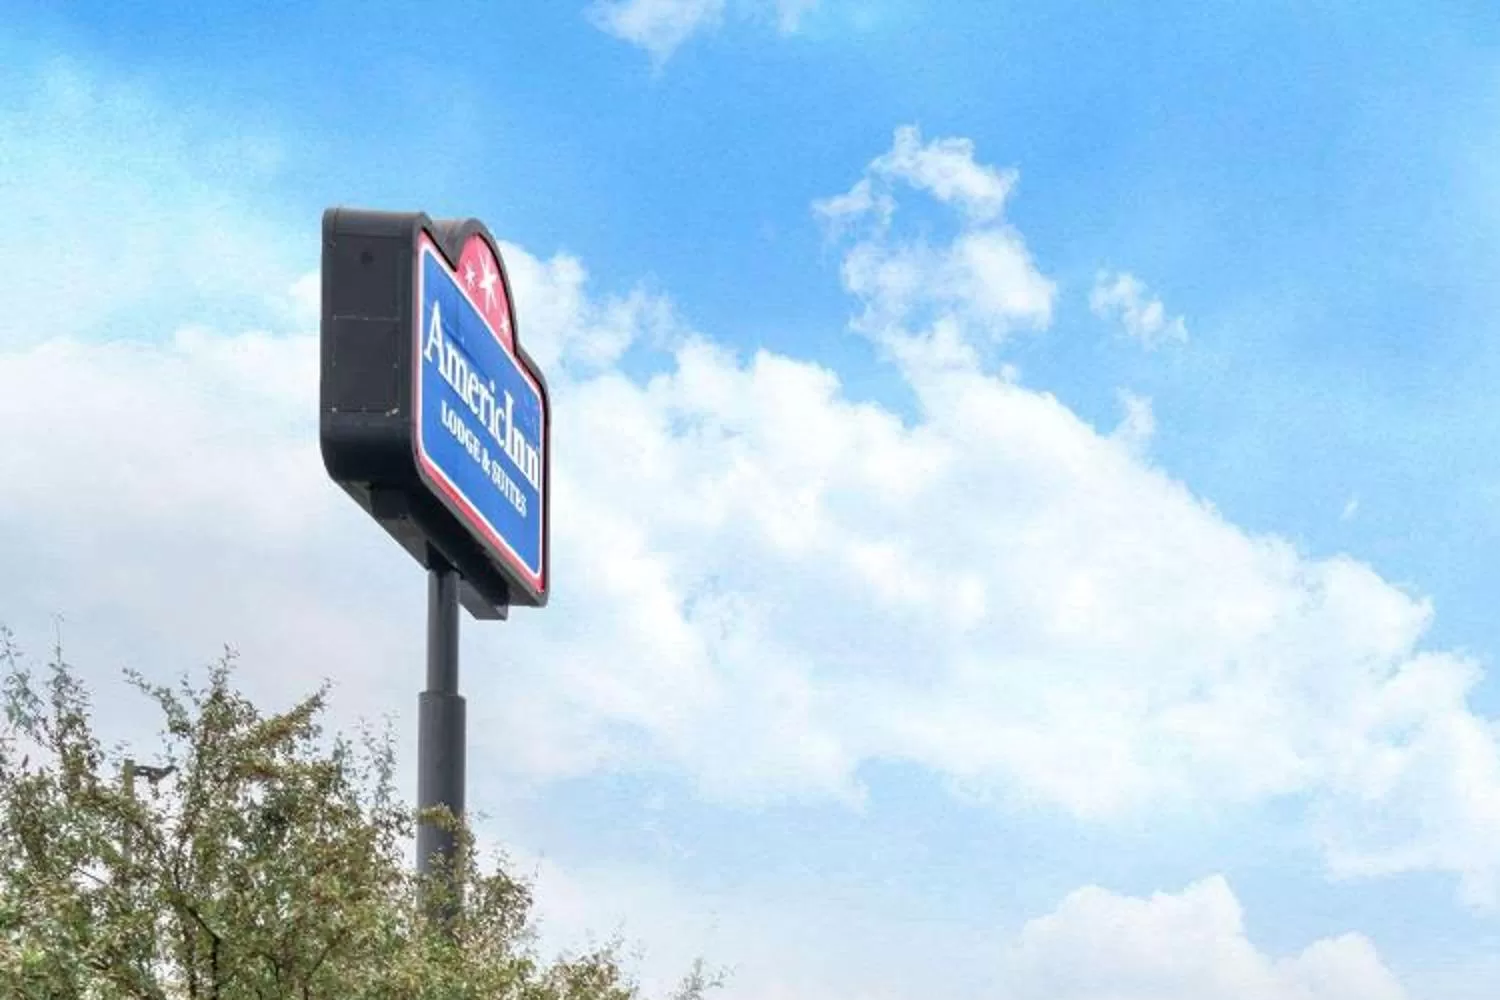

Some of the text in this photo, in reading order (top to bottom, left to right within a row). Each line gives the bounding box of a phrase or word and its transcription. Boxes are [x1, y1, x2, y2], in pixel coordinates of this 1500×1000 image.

[423, 300, 539, 491] AmericInn
[441, 399, 527, 518] LODGE & SUITES
